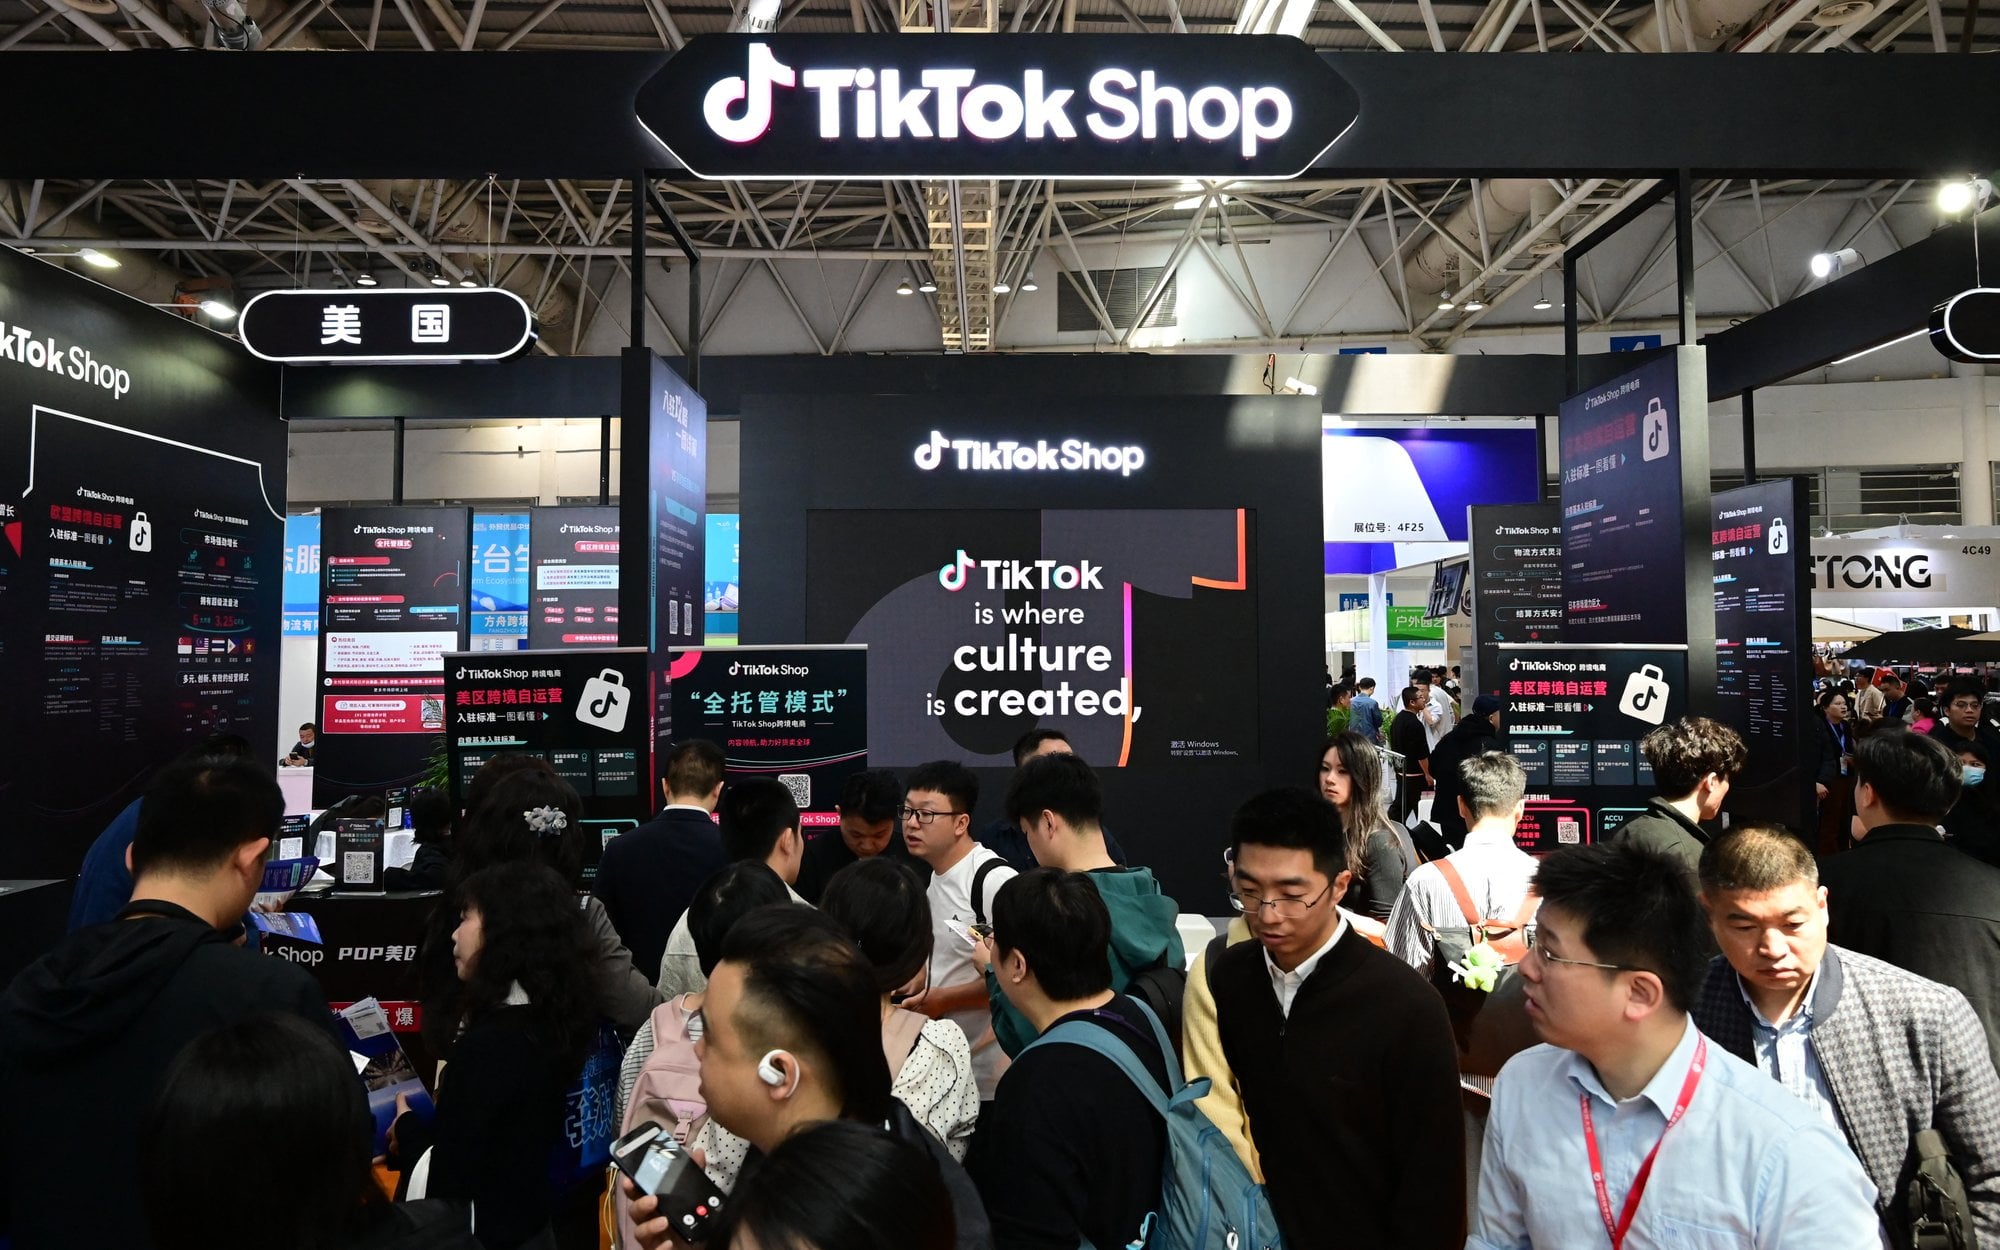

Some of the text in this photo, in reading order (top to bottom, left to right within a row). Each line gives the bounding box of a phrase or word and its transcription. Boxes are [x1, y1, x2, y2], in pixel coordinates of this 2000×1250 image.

[803, 67, 1294, 158] TikTok Shop
[320, 304, 450, 344] 美国
[66, 345, 130, 400] Shop
[952, 439, 1145, 476] TikTok Shop
[363, 526, 386, 535] TikTok
[387, 526, 406, 536] Shop
[569, 524, 613, 535] TikTok Shop
[1504, 526, 1529, 535] TikTok
[1530, 526, 1549, 536] Shop
[1962, 545, 1991, 555] 4C49
[980, 560, 1104, 590] TikTok
[974, 601, 1085, 625] is where
[953, 633, 1112, 671] culture
[742, 664, 809, 677] TikTok Shop
[1520, 661, 1607, 673] TikTok Shop 跨境电商
[468, 668, 562, 680] TikTok Shop 跨境电商
[1509, 681, 1608, 696] 美区跨境自运营
[456, 688, 563, 706] 美区跨境自运营
[690, 689, 848, 715] “全托管模式”
[926, 677, 1142, 723] is created,
[1509, 702, 1582, 713] 入驻标准一图看懂
[456, 711, 536, 723] 入驻标准一图看懂
[731, 720, 757, 728] TikTok
[457, 735, 516, 745] 自查基本入驻标准
[1187, 740, 1220, 749] Windows
[814, 815, 841, 827] Shop?
[277, 946, 324, 966] Shop
